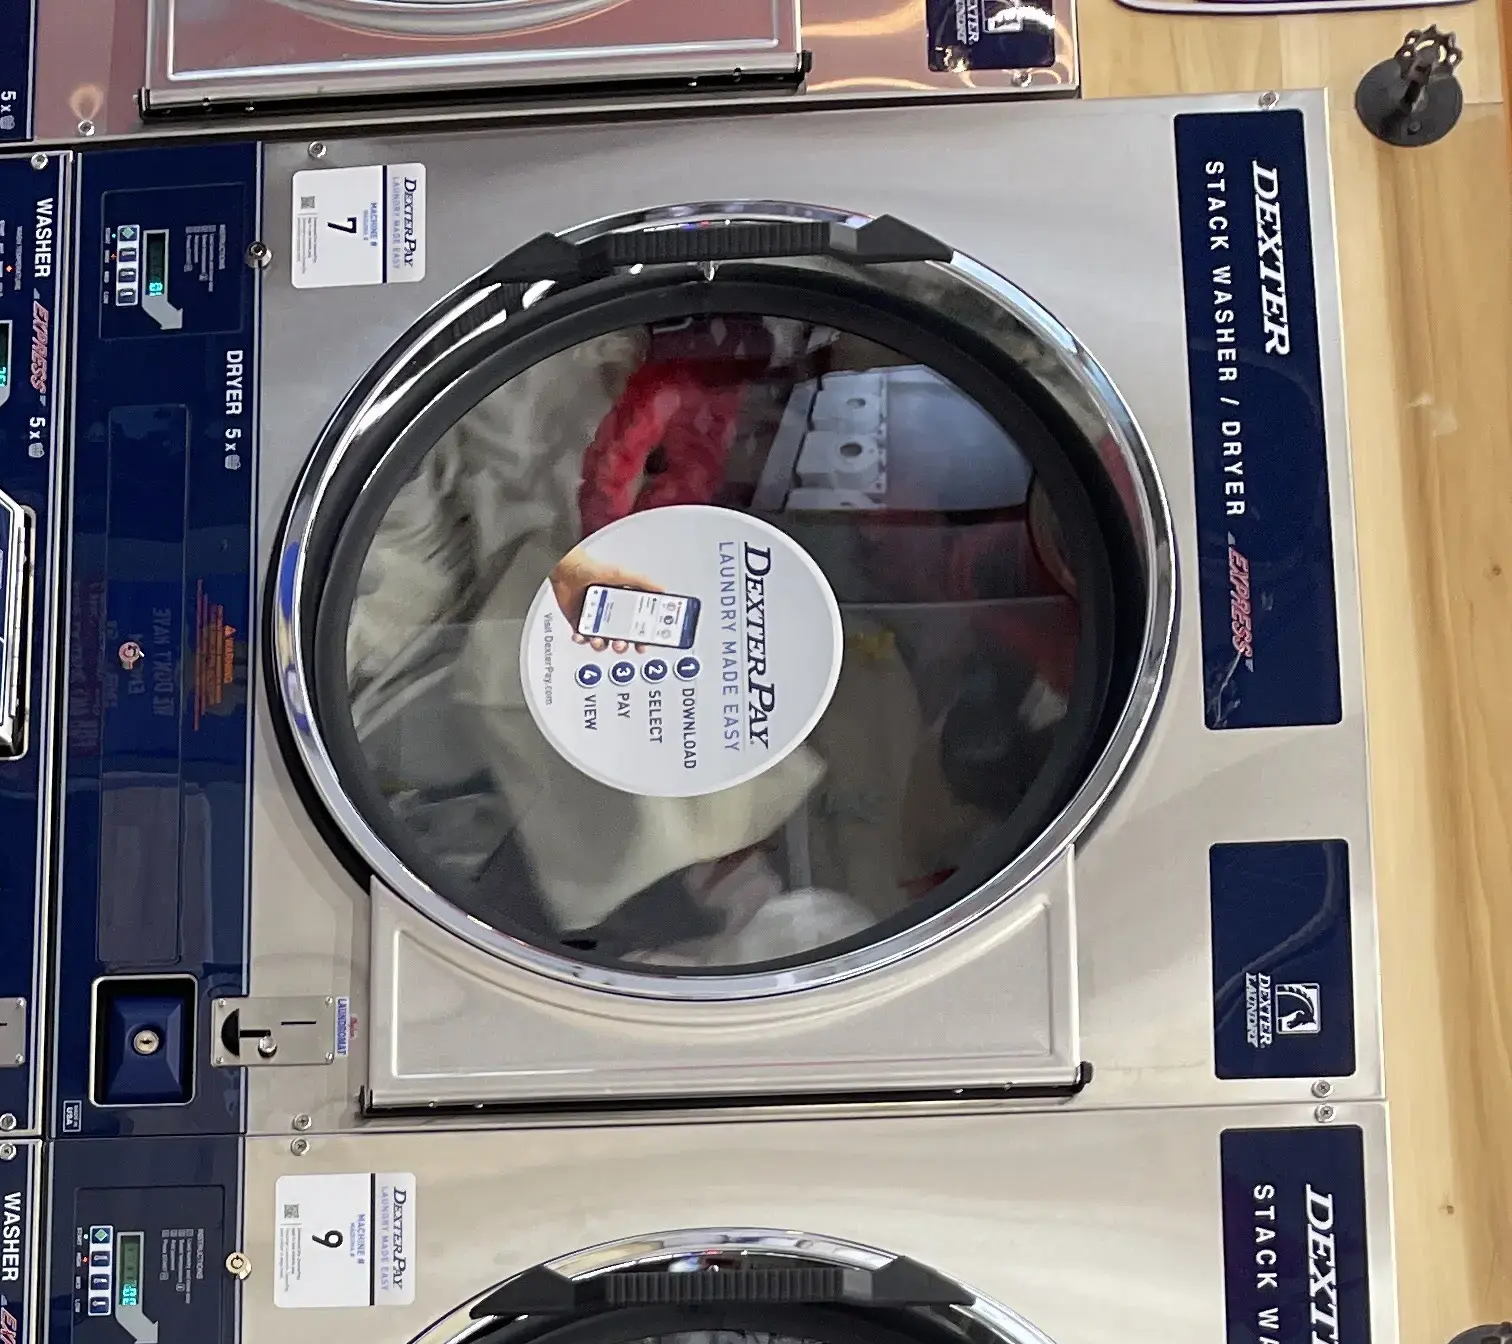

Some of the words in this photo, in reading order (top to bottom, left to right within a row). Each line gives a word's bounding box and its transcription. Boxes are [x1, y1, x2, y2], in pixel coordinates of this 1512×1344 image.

[0, 90, 16, 101] 5
[0, 104, 11, 113] x
[327, 217, 357, 234] 7
[1205, 161, 1229, 251] STACK
[34, 198, 53, 277] WASHER
[1252, 160, 1290, 353] DEXTER
[30, 301, 49, 394] EXPRESS
[1211, 267, 1238, 382] WASHER
[225, 350, 243, 415] DRYER
[1220, 397, 1242, 406] /
[29, 417, 45, 427] 5
[29, 431, 40, 439] x
[225, 428, 241, 439] 5
[225, 442, 237, 451] x
[1221, 422, 1246, 516] DRYER
[719, 541, 737, 633] LAUNDRY
[1228, 547, 1254, 660] EXPRESS
[543, 613, 554, 633] Visit
[722, 641, 738, 696] MADE
[583, 694, 597, 731] VIEW
[616, 693, 630, 720] PAY
[648, 690, 662, 744] SELECT
[682, 688, 697, 770] DOWNLOAD
[724, 704, 740, 752] EASY
[337, 998, 346, 1055] LAUNDROMAT
[1246, 972, 1258, 1047] LAUNDRY
[1258, 973, 1272, 1047] DEXTER
[1, 1192, 21, 1281] WASHER
[312, 1230, 344, 1248] 9
[1253, 1184, 1278, 1289] STACK
